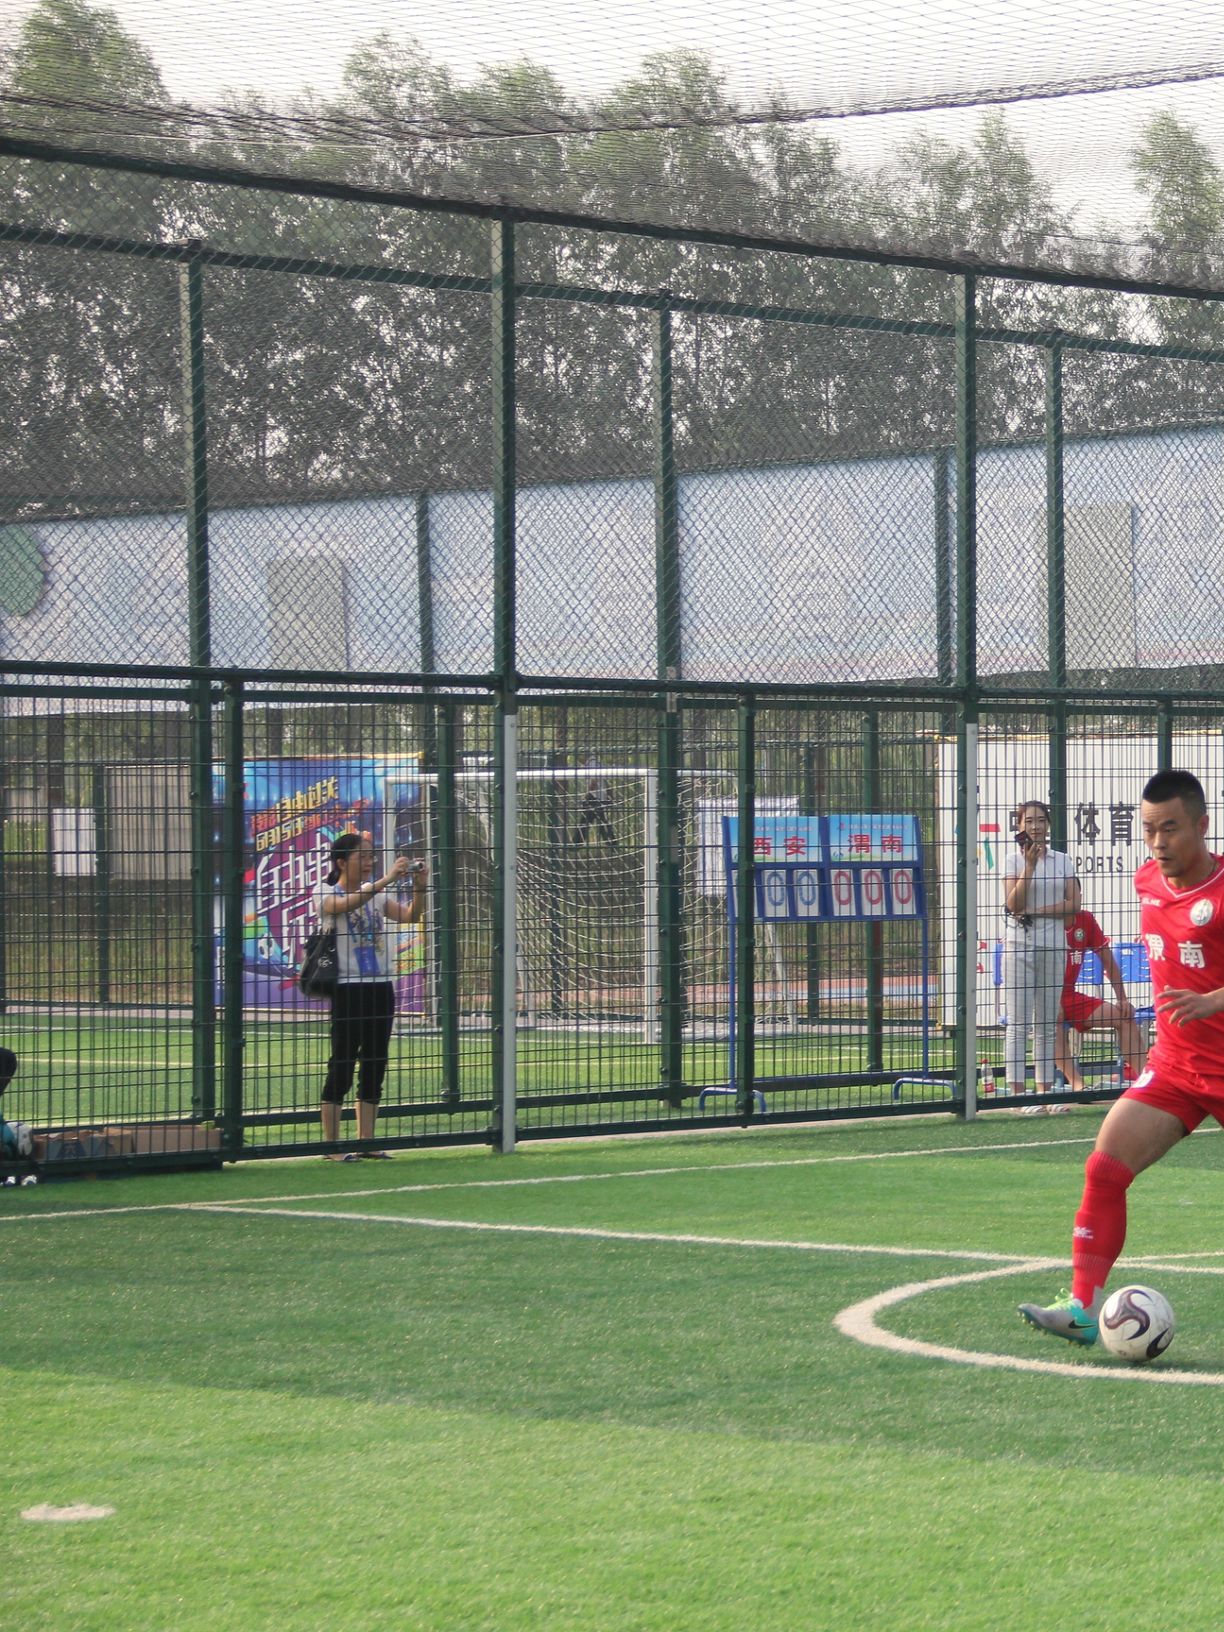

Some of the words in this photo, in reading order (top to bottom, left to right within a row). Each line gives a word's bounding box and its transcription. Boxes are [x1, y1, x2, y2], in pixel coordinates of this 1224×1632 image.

[753, 835, 807, 857] 西安
[847, 834, 904, 855] 渭南
[1071, 856, 1124, 873] PORTS
[766, 871, 786, 907] 0
[797, 871, 816, 906] 0
[833, 870, 853, 906] 0
[864, 870, 883, 905] 0
[893, 869, 913, 905] 0
